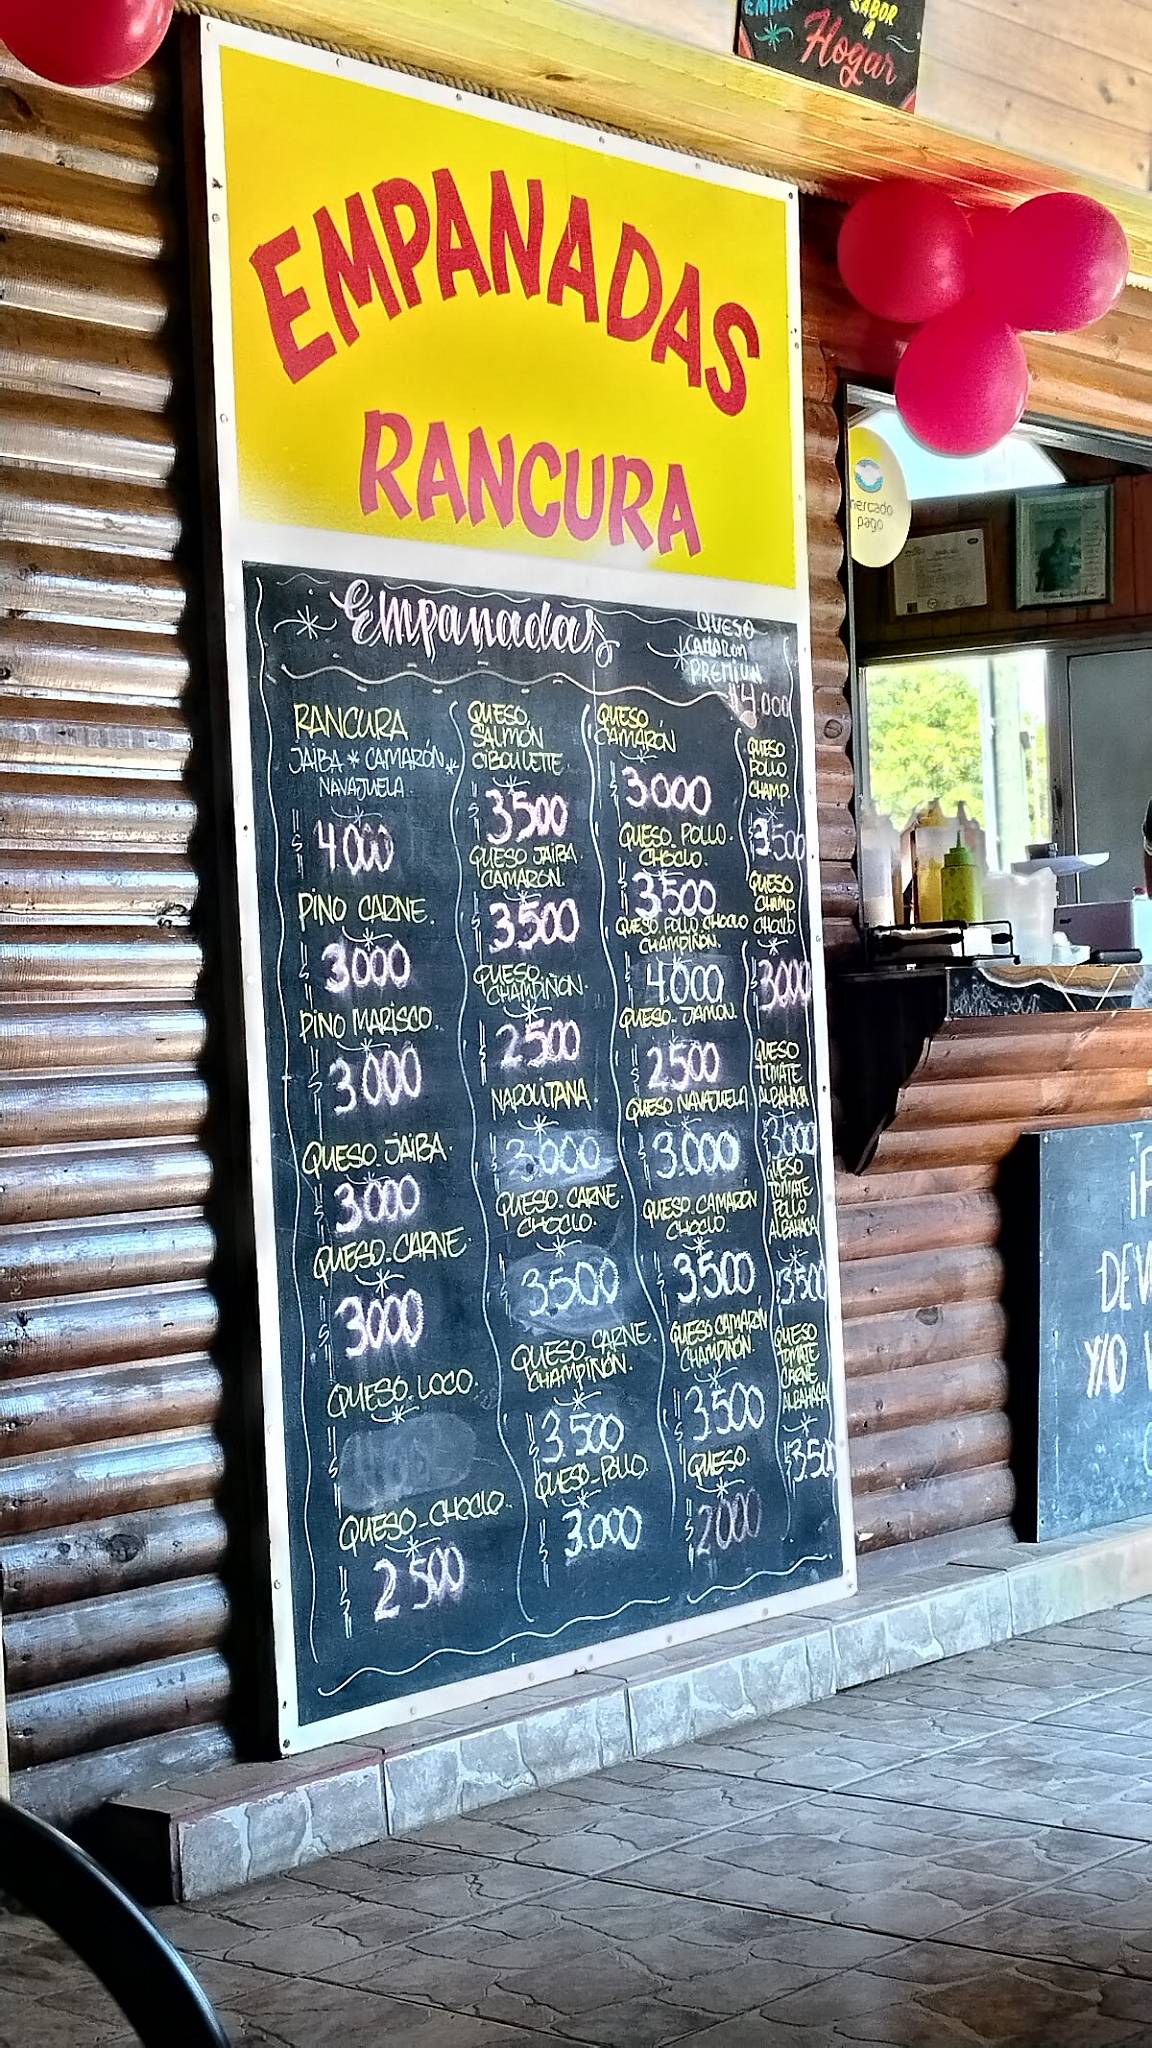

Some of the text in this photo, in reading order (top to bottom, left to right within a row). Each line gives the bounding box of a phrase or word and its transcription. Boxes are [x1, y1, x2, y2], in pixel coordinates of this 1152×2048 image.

[862, 19, 876, 39] A
[800, 7, 897, 88] Hogar
[249, 168, 760, 416] EMPANADAS
[360, 410, 702, 558] RANCURA
[857, 516, 884, 532] pago
[333, 579, 619, 667] Empanadas
[697, 609, 753, 640] QUESO
[293, 703, 409, 741] RANCURA
[596, 703, 649, 729] QUESO
[289, 743, 344, 774] JAIBA
[747, 736, 785, 760] QUESO
[749, 757, 787, 778] POLLO
[469, 845, 528, 877] QUESO
[749, 869, 794, 897] QUESO
[298, 887, 347, 932] PINO
[299, 1009, 346, 1043] PINO
[755, 1038, 799, 1061] QUESO
[626, 1096, 673, 1128] QUESO
[766, 1156, 804, 1181] QUESO
[767, 1176, 814, 1201] TOMATE
[774, 1322, 818, 1348] QUESO
[776, 1342, 820, 1368] TOMATE
